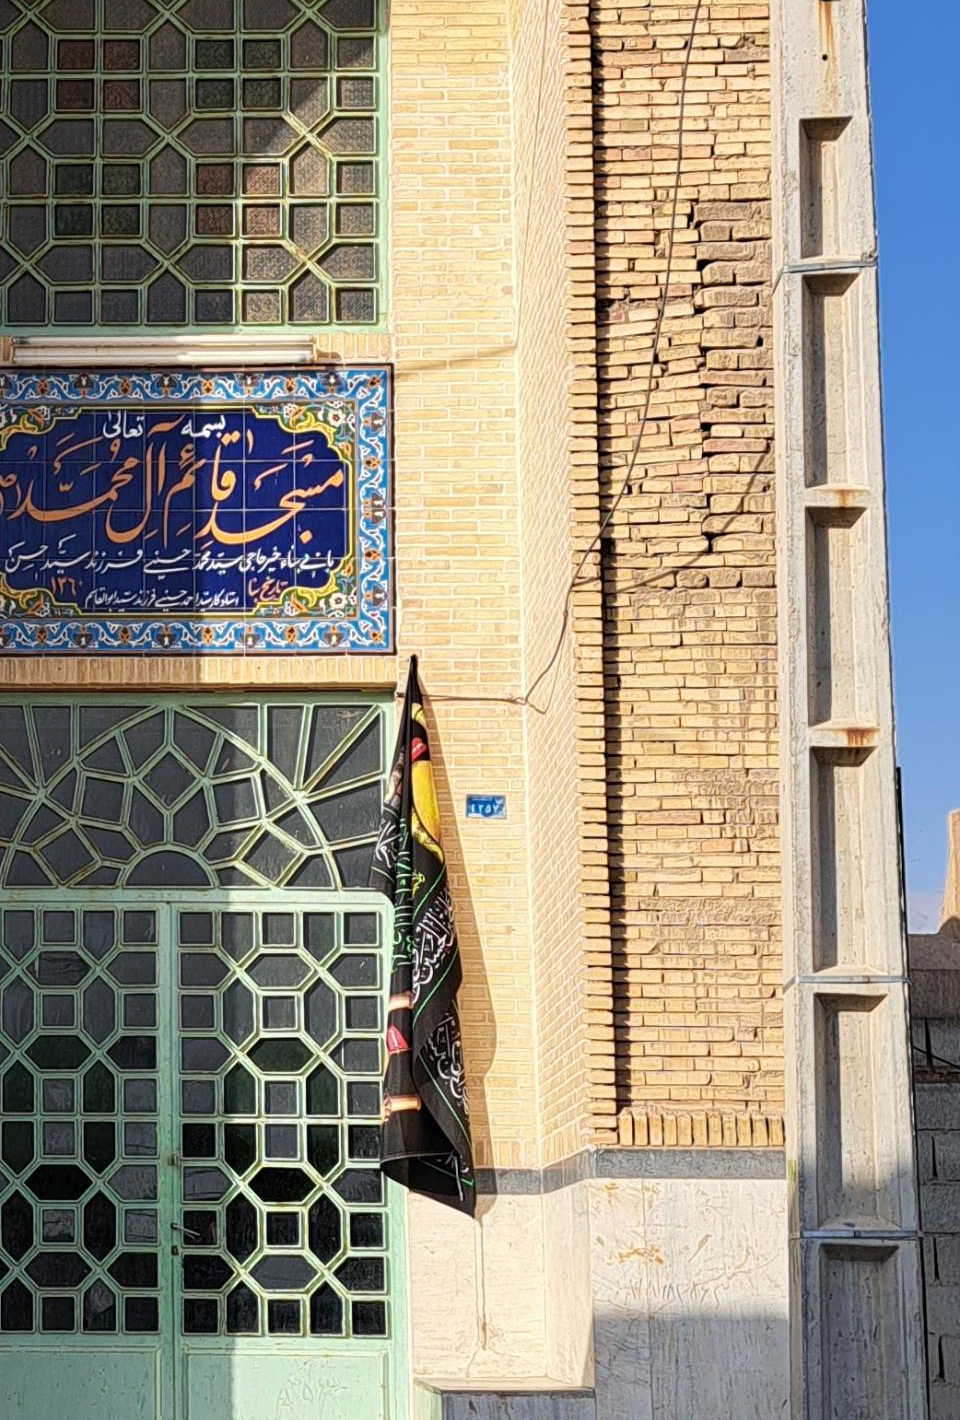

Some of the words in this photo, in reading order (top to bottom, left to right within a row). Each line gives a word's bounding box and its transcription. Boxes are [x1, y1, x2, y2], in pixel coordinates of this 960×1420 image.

[180, 414, 227, 439] بسمه
[7, 450, 141, 522] محمد
[193, 454, 344, 545] مسجد
